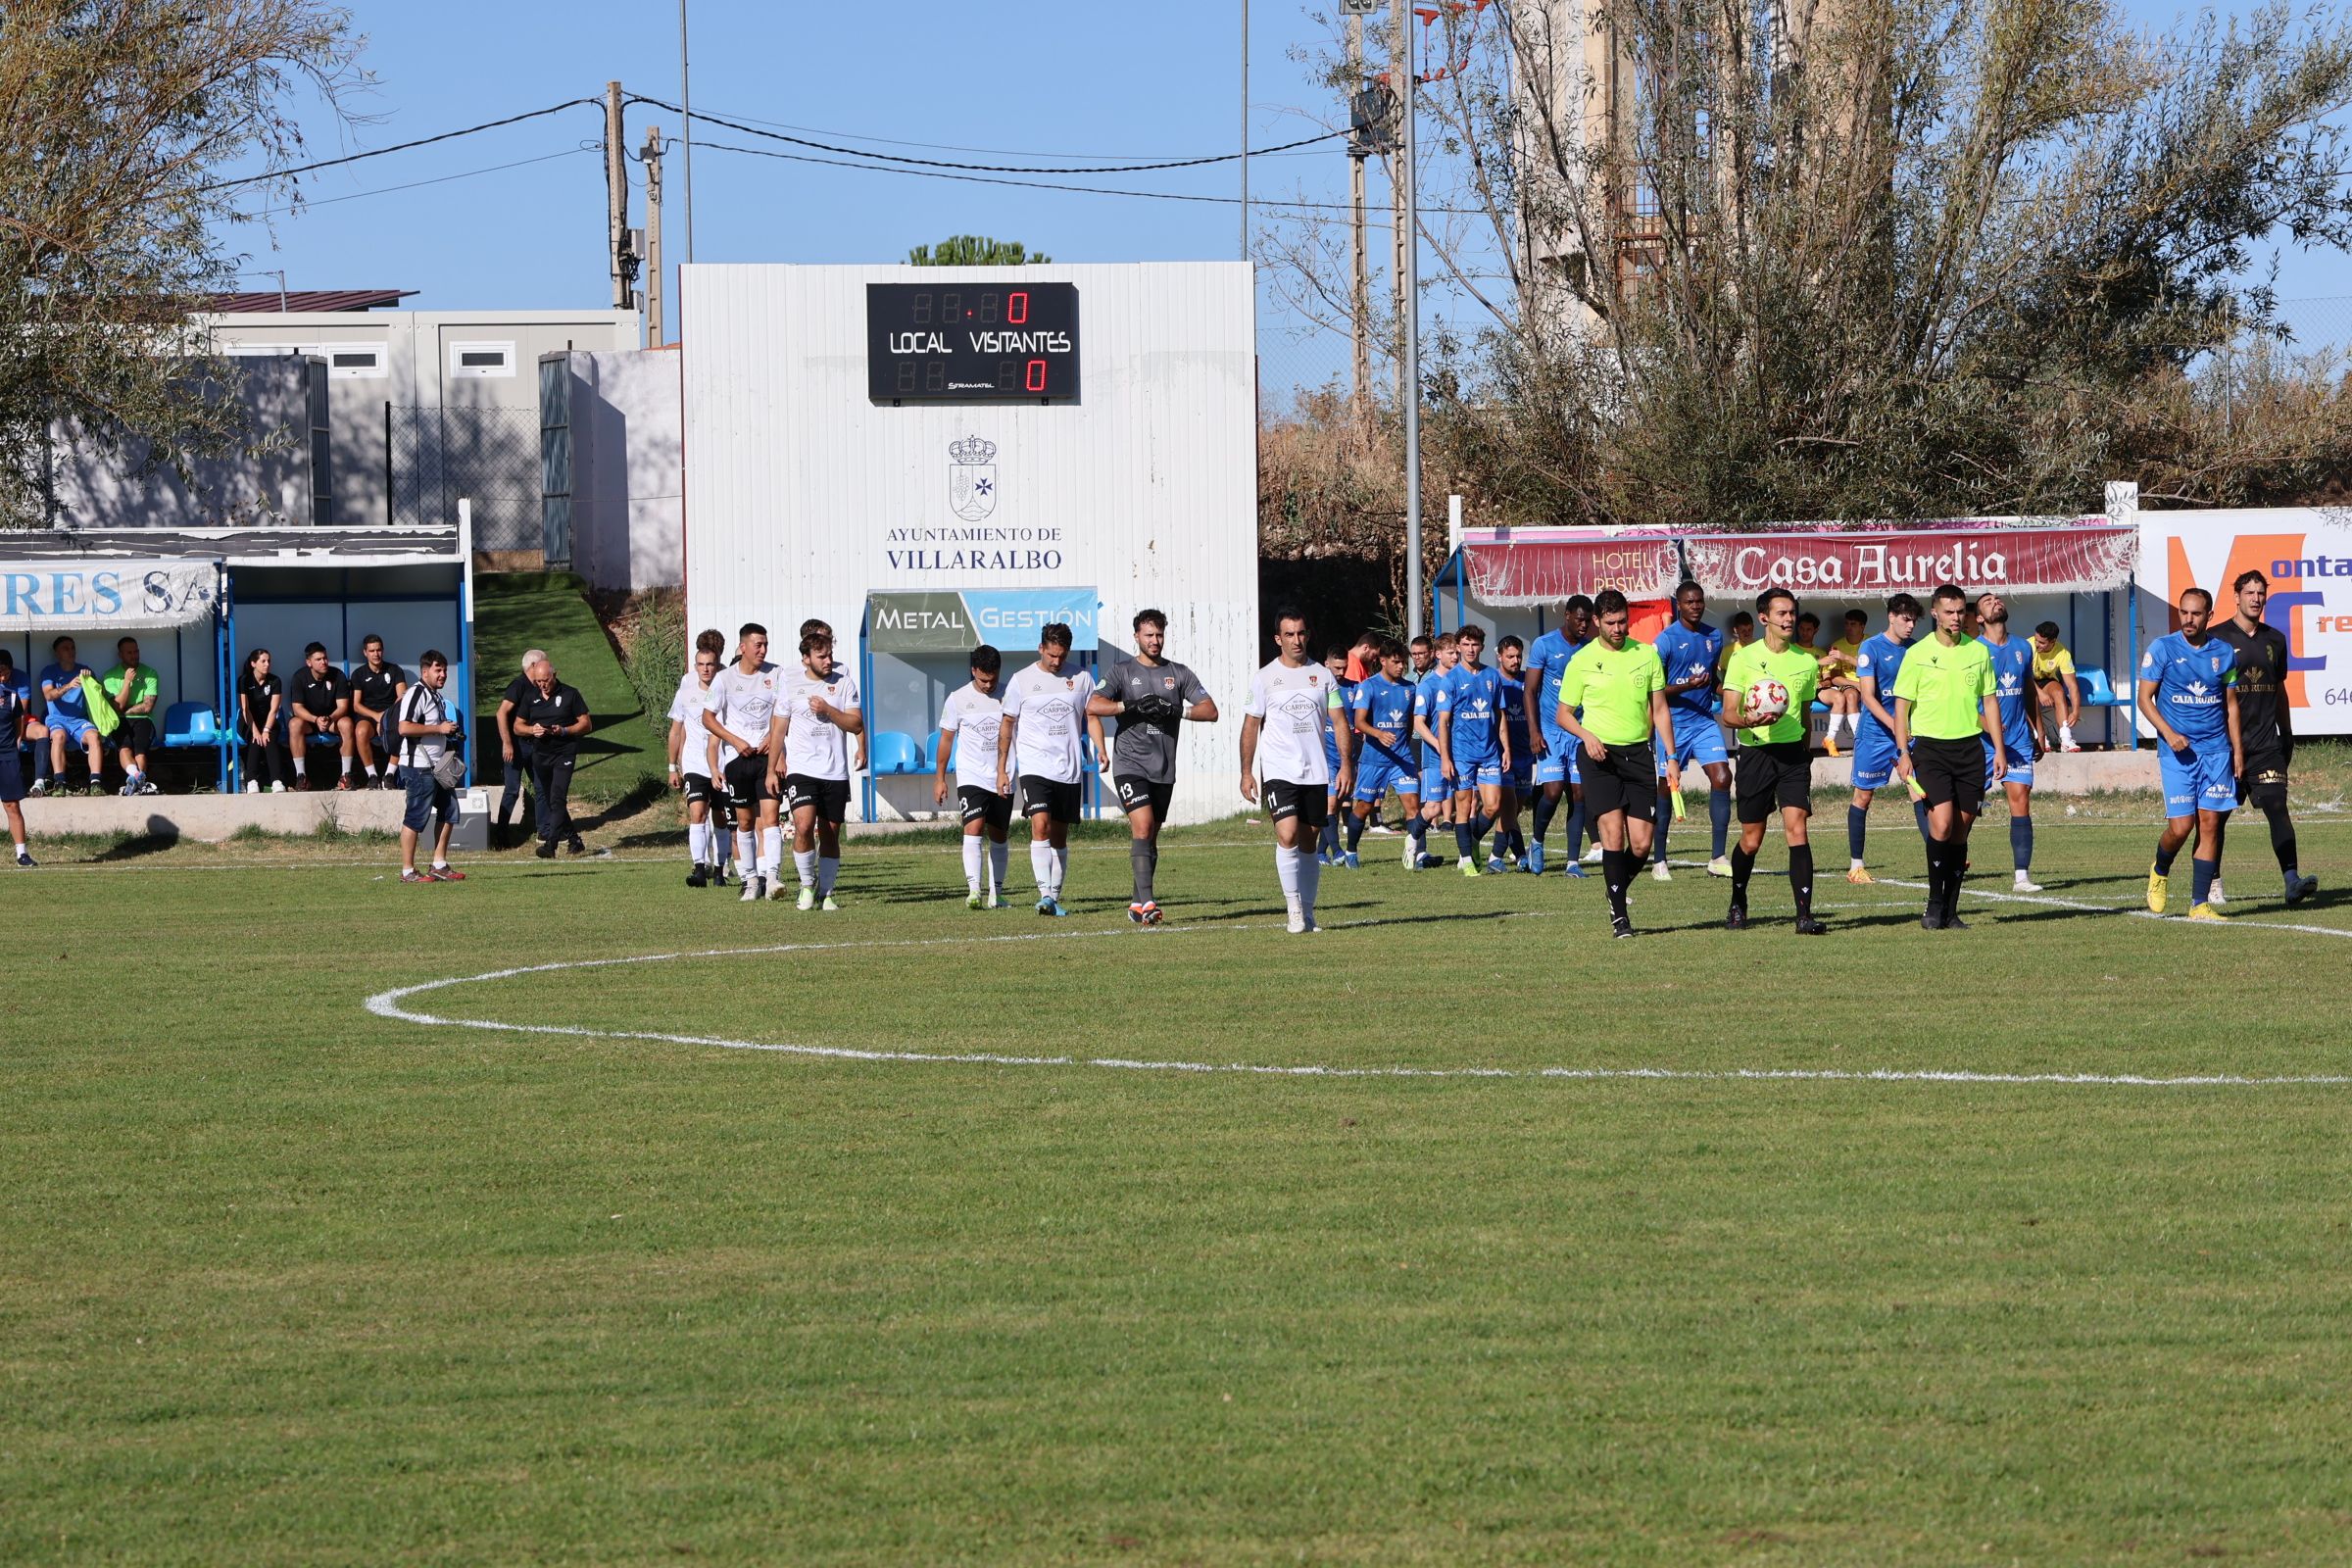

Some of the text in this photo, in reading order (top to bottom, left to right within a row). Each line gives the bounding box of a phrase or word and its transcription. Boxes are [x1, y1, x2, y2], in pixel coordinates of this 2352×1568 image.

[890, 331, 1071, 354] LOCAL VISITANTES
[1026, 360, 1047, 391] 0
[887, 527, 1062, 541] AYUNTAMIENTO DE
[887, 549, 1062, 569] VILLARALBO
[1592, 552, 1652, 569] HOTEL
[1734, 541, 2006, 585] Casa Aurelia
[875, 609, 964, 629] METAL
[1120, 782, 1134, 800] 13
[1267, 791, 1278, 809] 11
